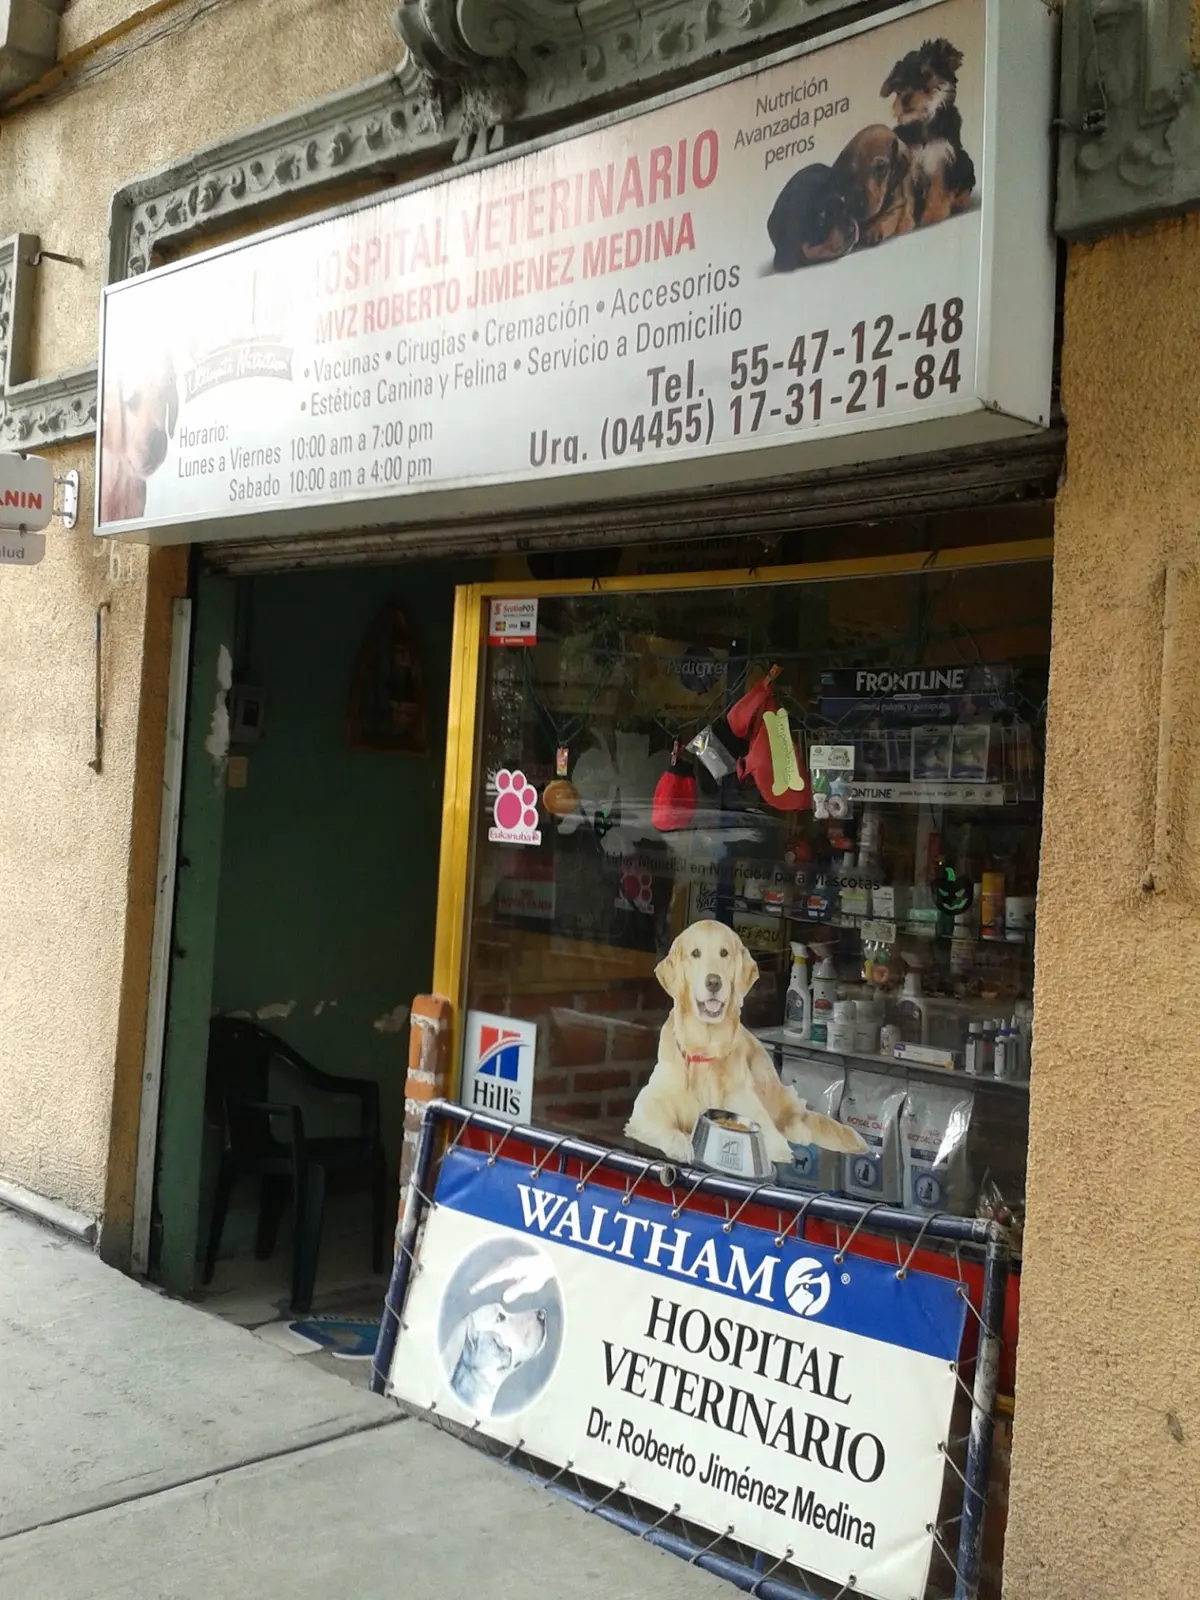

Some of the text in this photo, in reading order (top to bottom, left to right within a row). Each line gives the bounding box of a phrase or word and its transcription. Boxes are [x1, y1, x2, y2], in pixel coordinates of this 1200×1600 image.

[734, 97, 850, 150] Avanzada para
[755, 76, 828, 117] Nutrición
[461, 128, 720, 259] VETERINARIO
[764, 134, 815, 169] perros
[316, 211, 696, 346] MVZ ROBERTO JIMENEZ MEDINA
[310, 306, 743, 418] Estética Canina y Felina Servicio a Domicilio
[313, 263, 741, 384] Vacunas Cirugías Cremación Accesorios
[648, 296, 965, 407] Tel. 55-47-12-48
[179, 421, 229, 449] Horario:
[601, 398, 715, 462] (04455)
[730, 347, 961, 436] 17-31-21-84
[178, 420, 433, 479] Lunes a Viernes 10:00 am a 7:00 pm
[229, 455, 432, 502] Sabado 10:00 am a 4:00 pm
[856, 669, 964, 692] FRONTLINE
[490, 830, 531, 841] Eukanuba
[851, 787, 893, 799] ONTLINE
[472, 1078, 521, 1116] Hill's
[516, 1183, 782, 1303] WALTHAM
[643, 1295, 852, 1406] HOSPITAL
[601, 1340, 886, 1485] VETERINARIO
[586, 1405, 876, 1550] Dr. Roberto Jiménez Medina
